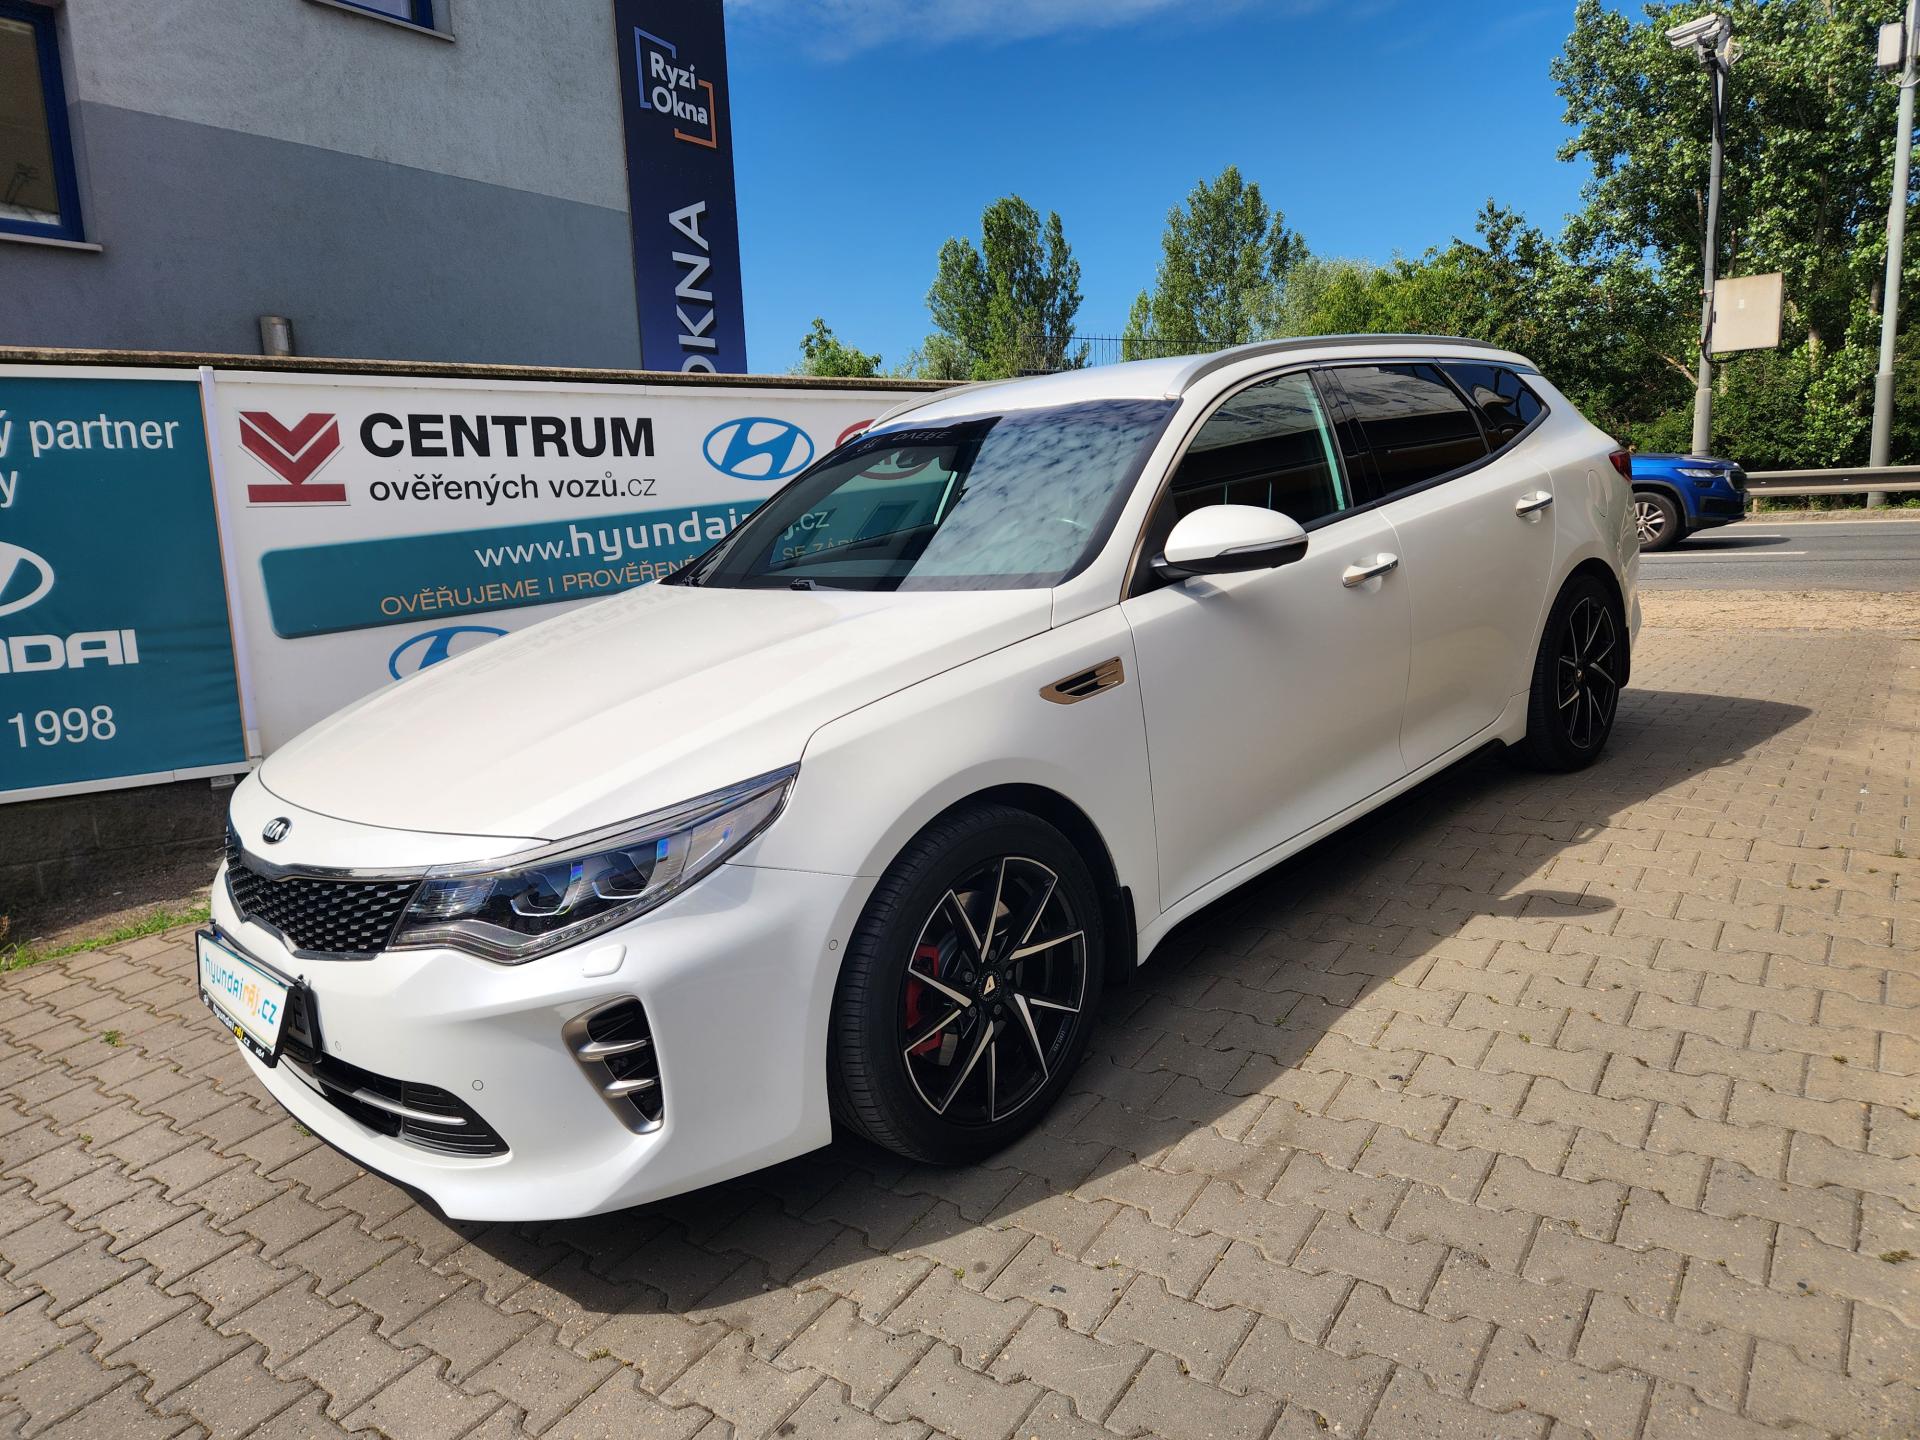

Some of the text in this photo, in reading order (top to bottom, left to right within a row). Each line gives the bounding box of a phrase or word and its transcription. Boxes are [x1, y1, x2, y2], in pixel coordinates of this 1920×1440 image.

[651, 86, 709, 125] Okna
[28, 413, 180, 458] partner
[359, 412, 656, 458] CENTRUM
[368, 472, 539, 506] ověřených
[380, 578, 540, 617] OVĚŘUJEME
[8, 704, 117, 748] 1998
